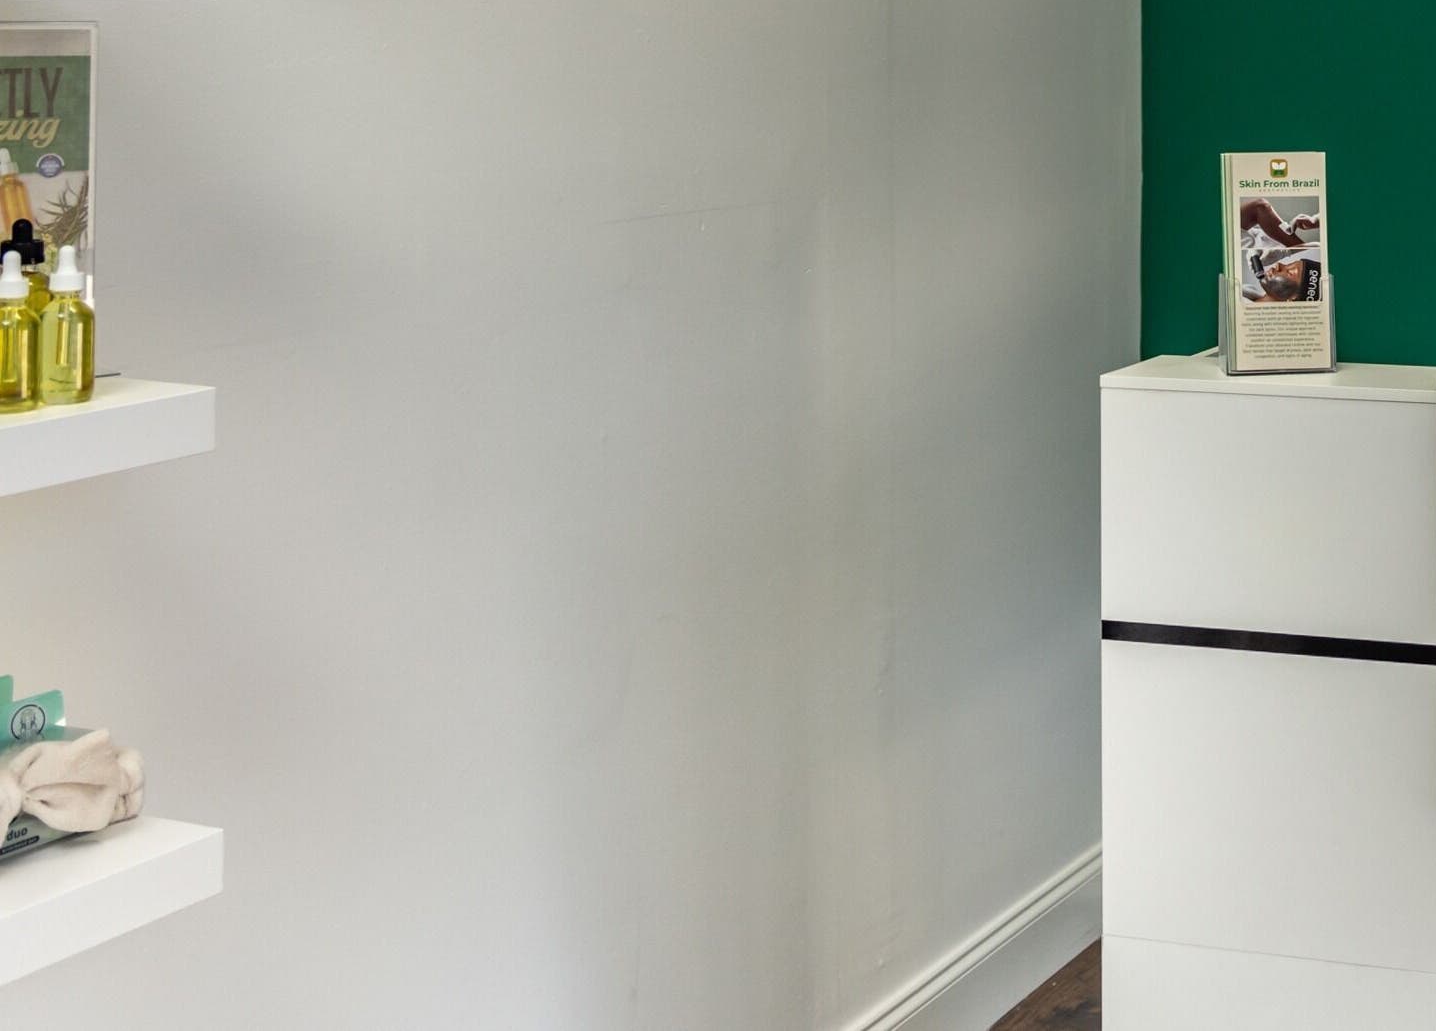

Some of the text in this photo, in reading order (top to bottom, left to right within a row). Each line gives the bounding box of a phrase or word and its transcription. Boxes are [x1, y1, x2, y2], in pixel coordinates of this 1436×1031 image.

[0, 67, 64, 119] TLY
[1239, 178, 1320, 188] Skin From Brazil
[6, 827, 28, 841] duo
